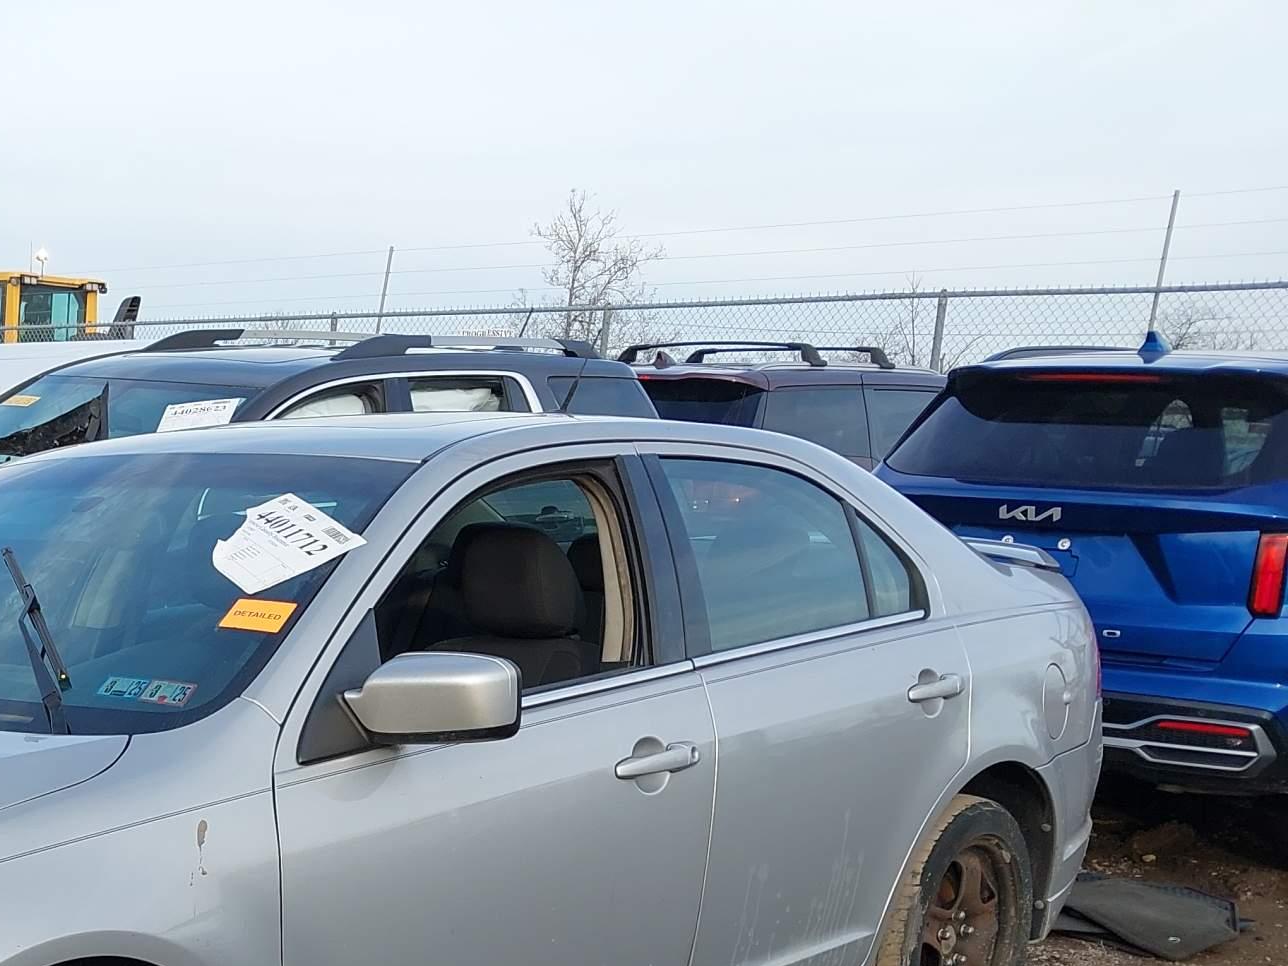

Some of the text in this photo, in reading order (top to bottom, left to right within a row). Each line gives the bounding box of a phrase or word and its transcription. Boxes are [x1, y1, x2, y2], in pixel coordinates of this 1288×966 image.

[999, 504, 1062, 522] KIA
[256, 510, 328, 556] 44011712
[233, 609, 282, 621] DETAILED
